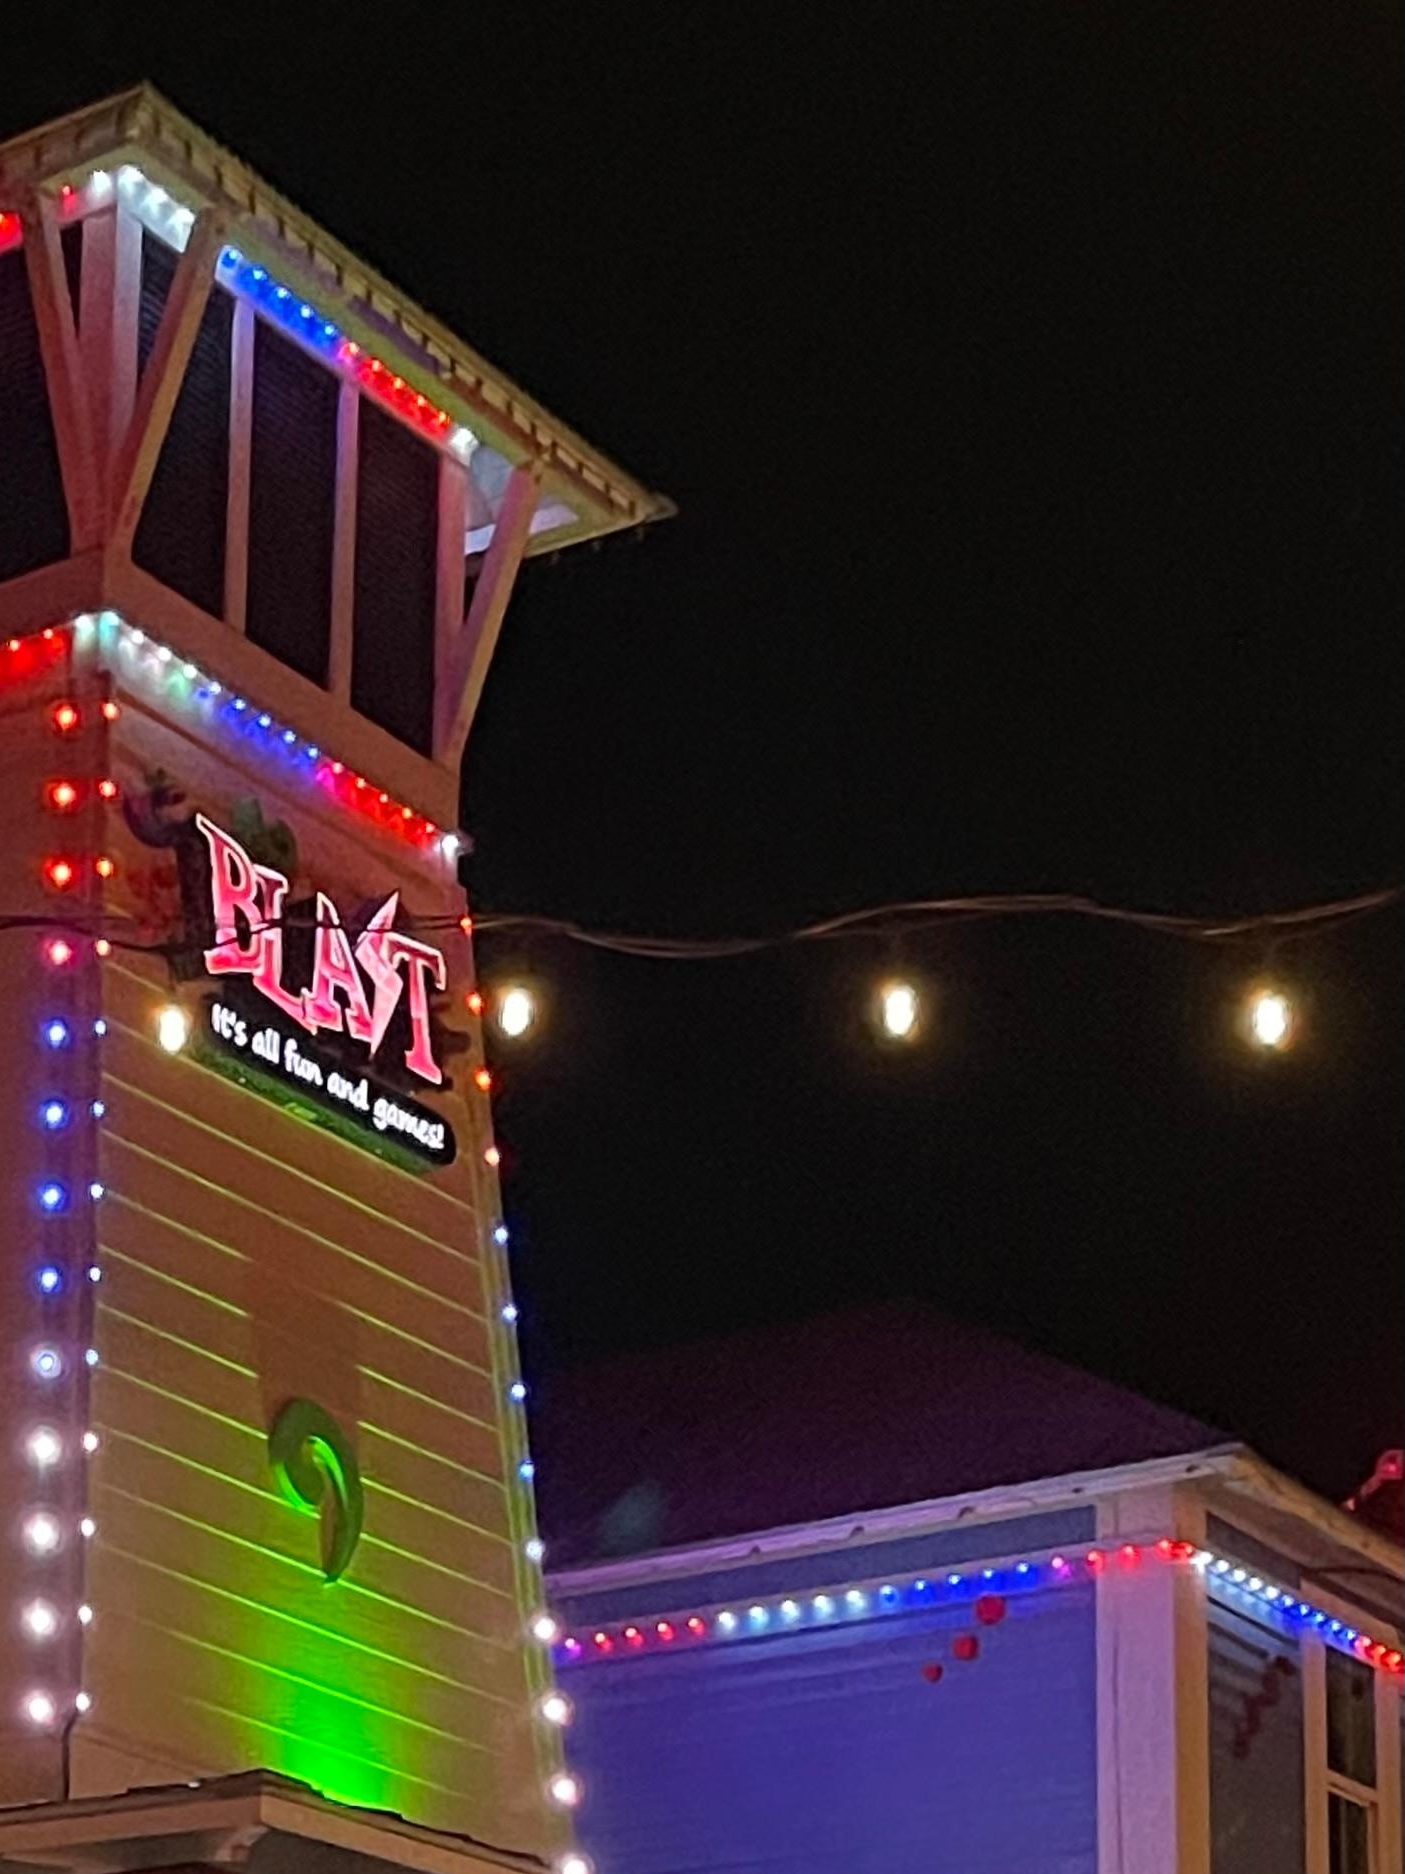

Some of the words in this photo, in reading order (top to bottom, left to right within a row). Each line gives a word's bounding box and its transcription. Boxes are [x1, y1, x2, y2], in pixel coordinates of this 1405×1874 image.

[196, 813, 447, 1084] BLAST
[252, 1028, 280, 1064] all
[284, 1038, 323, 1086] fun
[327, 1072, 370, 1111] and
[373, 1098, 444, 1149] games!
